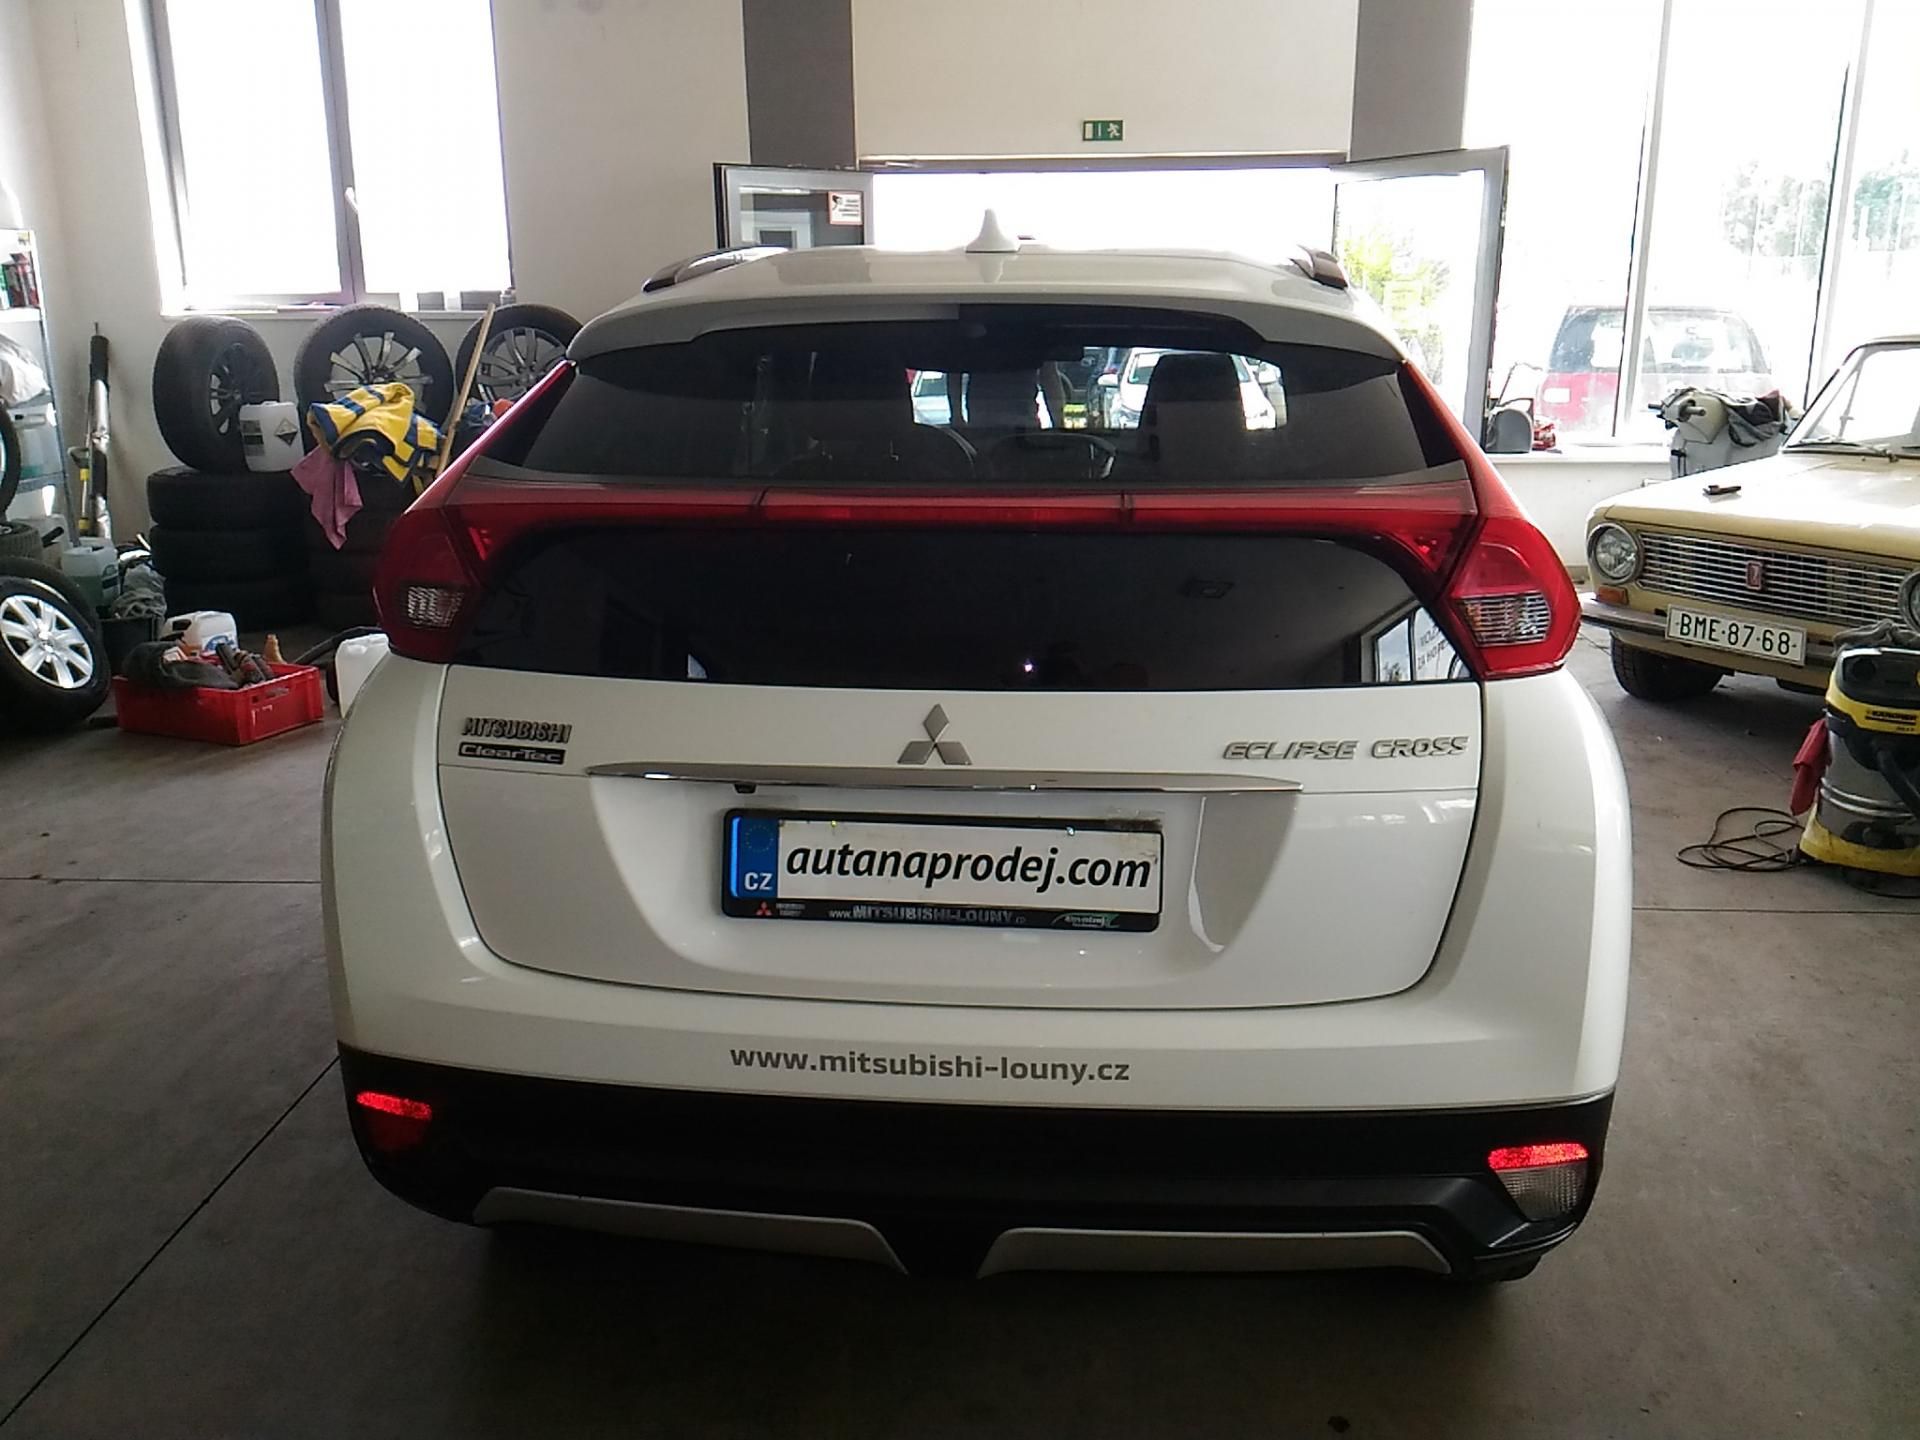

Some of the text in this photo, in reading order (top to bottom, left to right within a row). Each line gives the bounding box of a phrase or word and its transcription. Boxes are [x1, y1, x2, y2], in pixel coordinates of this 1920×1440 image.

[462, 717, 573, 744] MITSUBISHI
[461, 744, 561, 763] ClearTec
[1223, 736, 1469, 760] ECLIPSE CROSS
[786, 843, 1151, 893] autanaprodej.com
[744, 872, 773, 890] CZ
[730, 1047, 1131, 1086] www.mitsubishi-louny.cz
